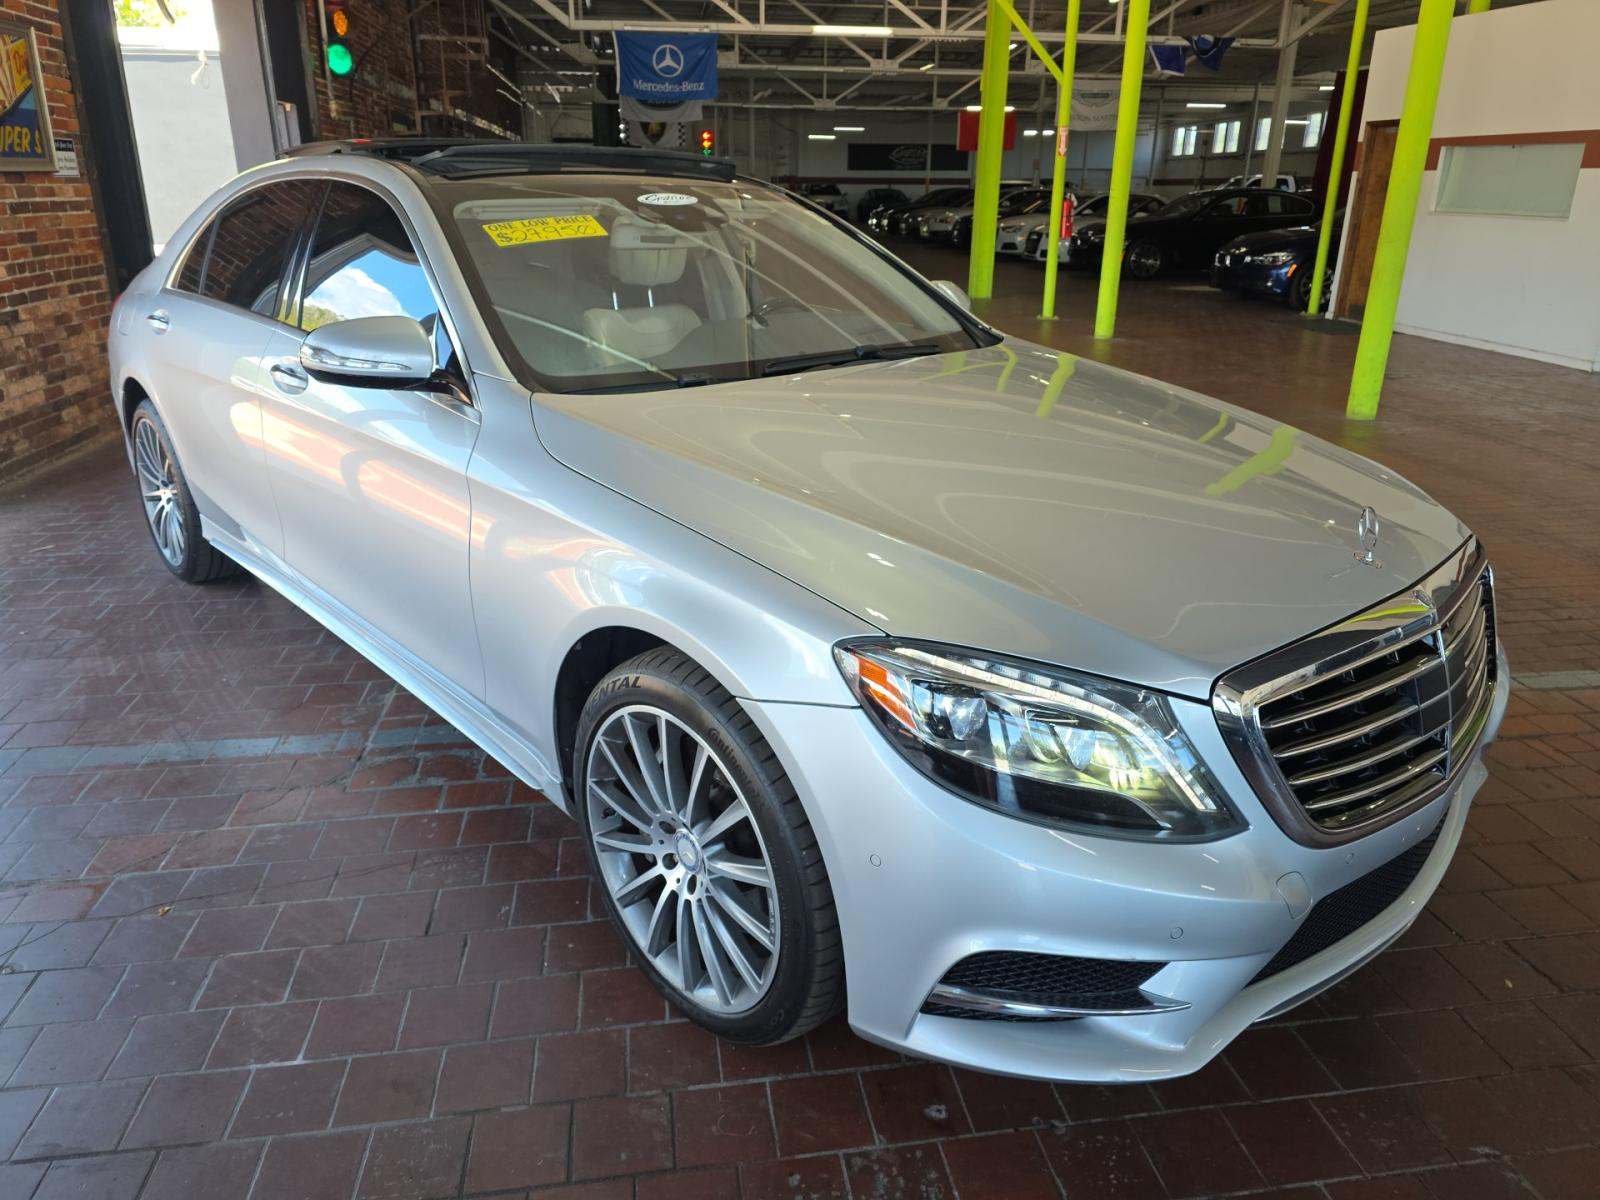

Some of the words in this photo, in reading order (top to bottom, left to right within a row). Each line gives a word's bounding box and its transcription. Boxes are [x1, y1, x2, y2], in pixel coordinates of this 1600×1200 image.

[633, 80, 704, 93] Mercedes-Benz
[487, 222, 514, 232] ONE
[520, 218, 549, 228] LOW
[554, 214, 590, 224] PRICE
